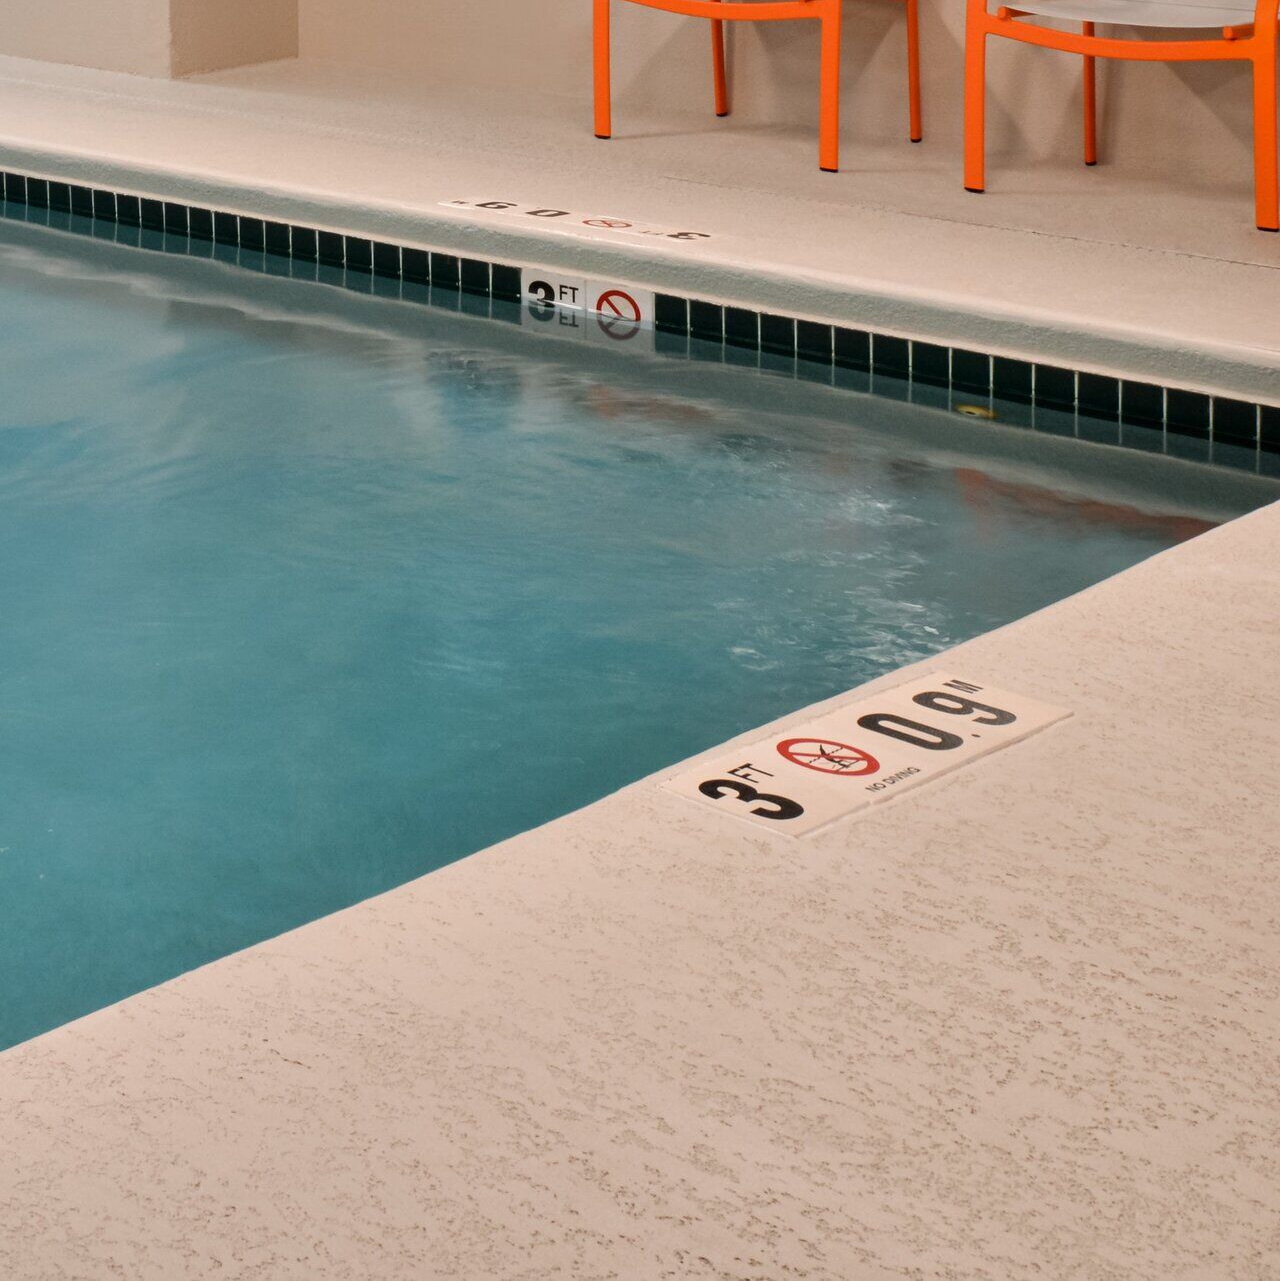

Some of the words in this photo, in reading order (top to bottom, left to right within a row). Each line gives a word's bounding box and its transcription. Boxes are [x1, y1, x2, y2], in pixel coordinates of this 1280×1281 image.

[559, 284, 579, 304] FT
[941, 679, 984, 694] M
[729, 762, 774, 784] FT
[865, 782, 887, 793] NO
[886, 767, 921, 788] DIVING
[698, 778, 804, 821] 3
